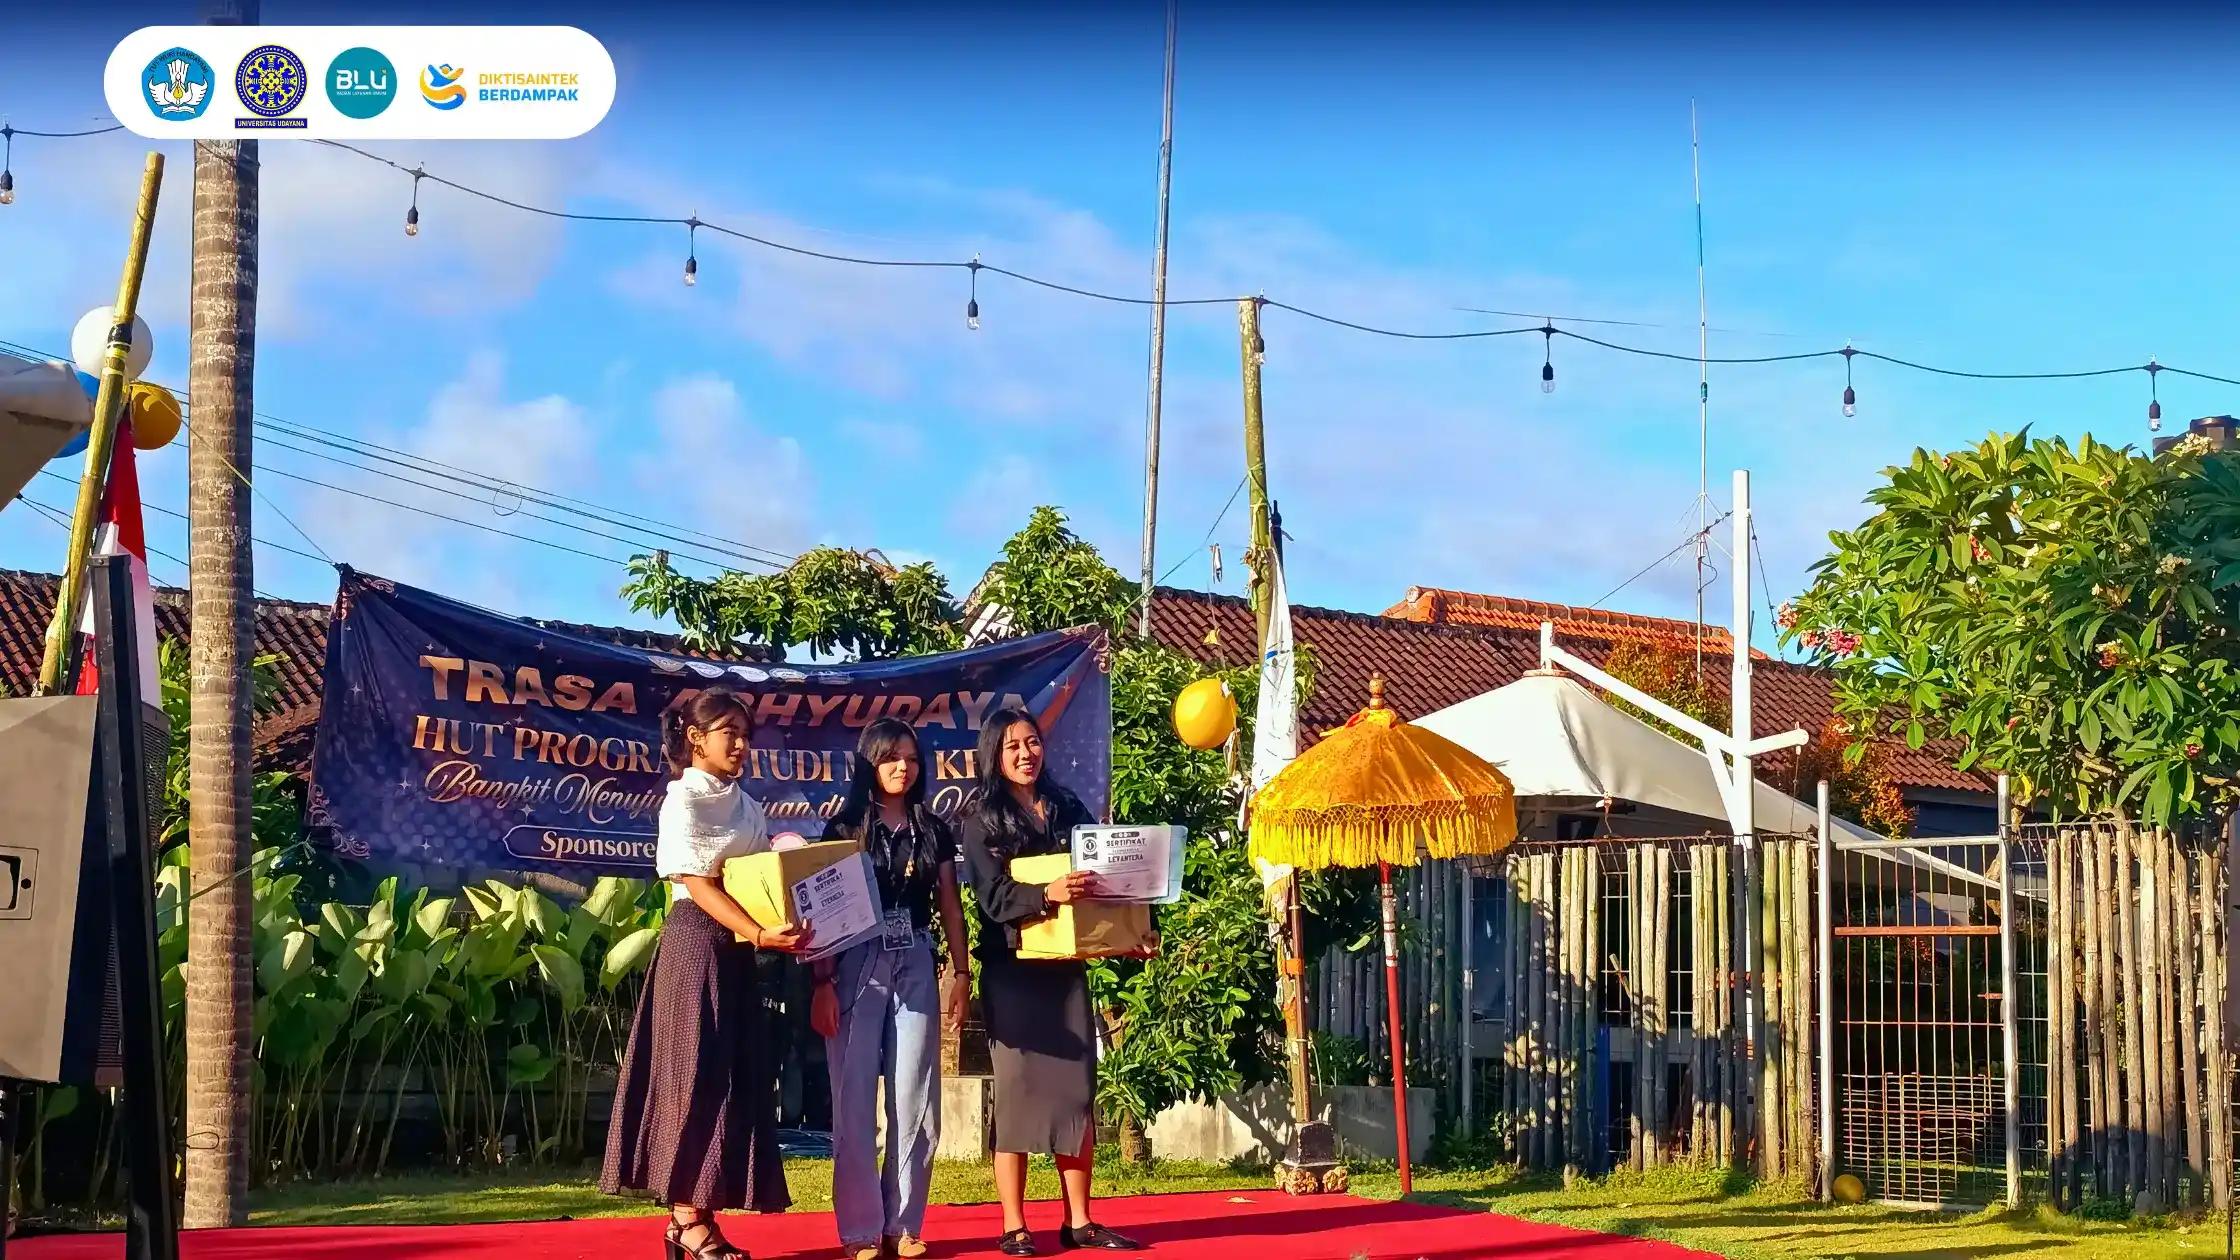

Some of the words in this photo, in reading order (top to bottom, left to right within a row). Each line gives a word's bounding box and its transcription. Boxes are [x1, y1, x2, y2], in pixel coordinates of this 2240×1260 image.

[419, 654, 638, 715] TRASA
[658, 687, 1029, 731] HYUDAYA
[412, 715, 504, 758] HUT
[512, 727, 678, 775] PROGRA
[735, 747, 834, 782] TUDI
[424, 760, 552, 809] Bangkit
[541, 830, 656, 859] Sponsore
[1105, 838, 1147, 848] SERTIFIKAT
